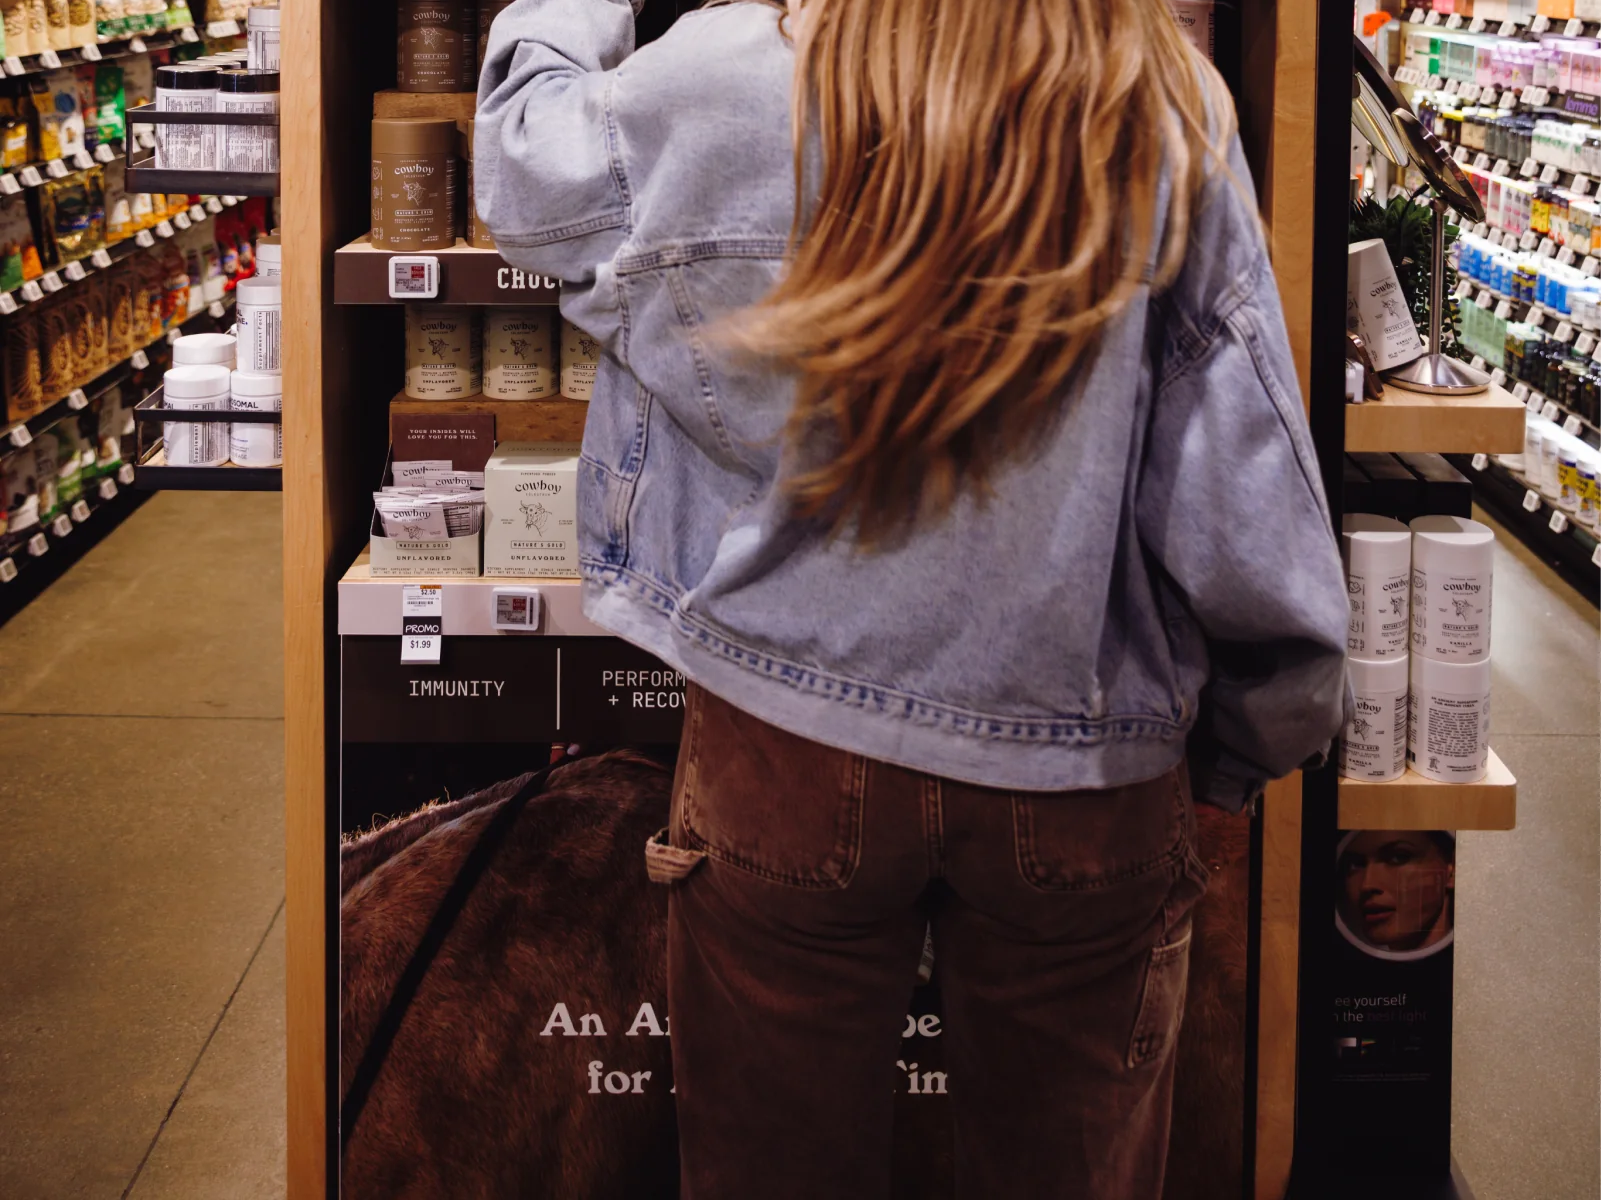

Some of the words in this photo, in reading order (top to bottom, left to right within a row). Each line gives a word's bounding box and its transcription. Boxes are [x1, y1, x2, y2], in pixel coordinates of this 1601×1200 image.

[412, 10, 450, 22] cowboy
[394, 164, 434, 176] cowboy
[497, 267, 562, 289] CHOC
[420, 321, 457, 333] cowboy
[502, 322, 539, 333] cowboy
[435, 476, 472, 487] cowboy
[515, 480, 562, 494] cowboy
[392, 508, 431, 520] cowboy
[1443, 582, 1481, 593] cowboy
[405, 624, 439, 633] PROMO
[410, 639, 431, 649] $1.99
[602, 670, 686, 687] PERFORM
[409, 680, 505, 697] IMMUNITY
[1335, 997, 1351, 1007] ee
[1353, 993, 1407, 1010] yourself
[540, 1002, 607, 1037] An
[1343, 1011, 1364, 1022] the
[588, 1060, 652, 1094] for
